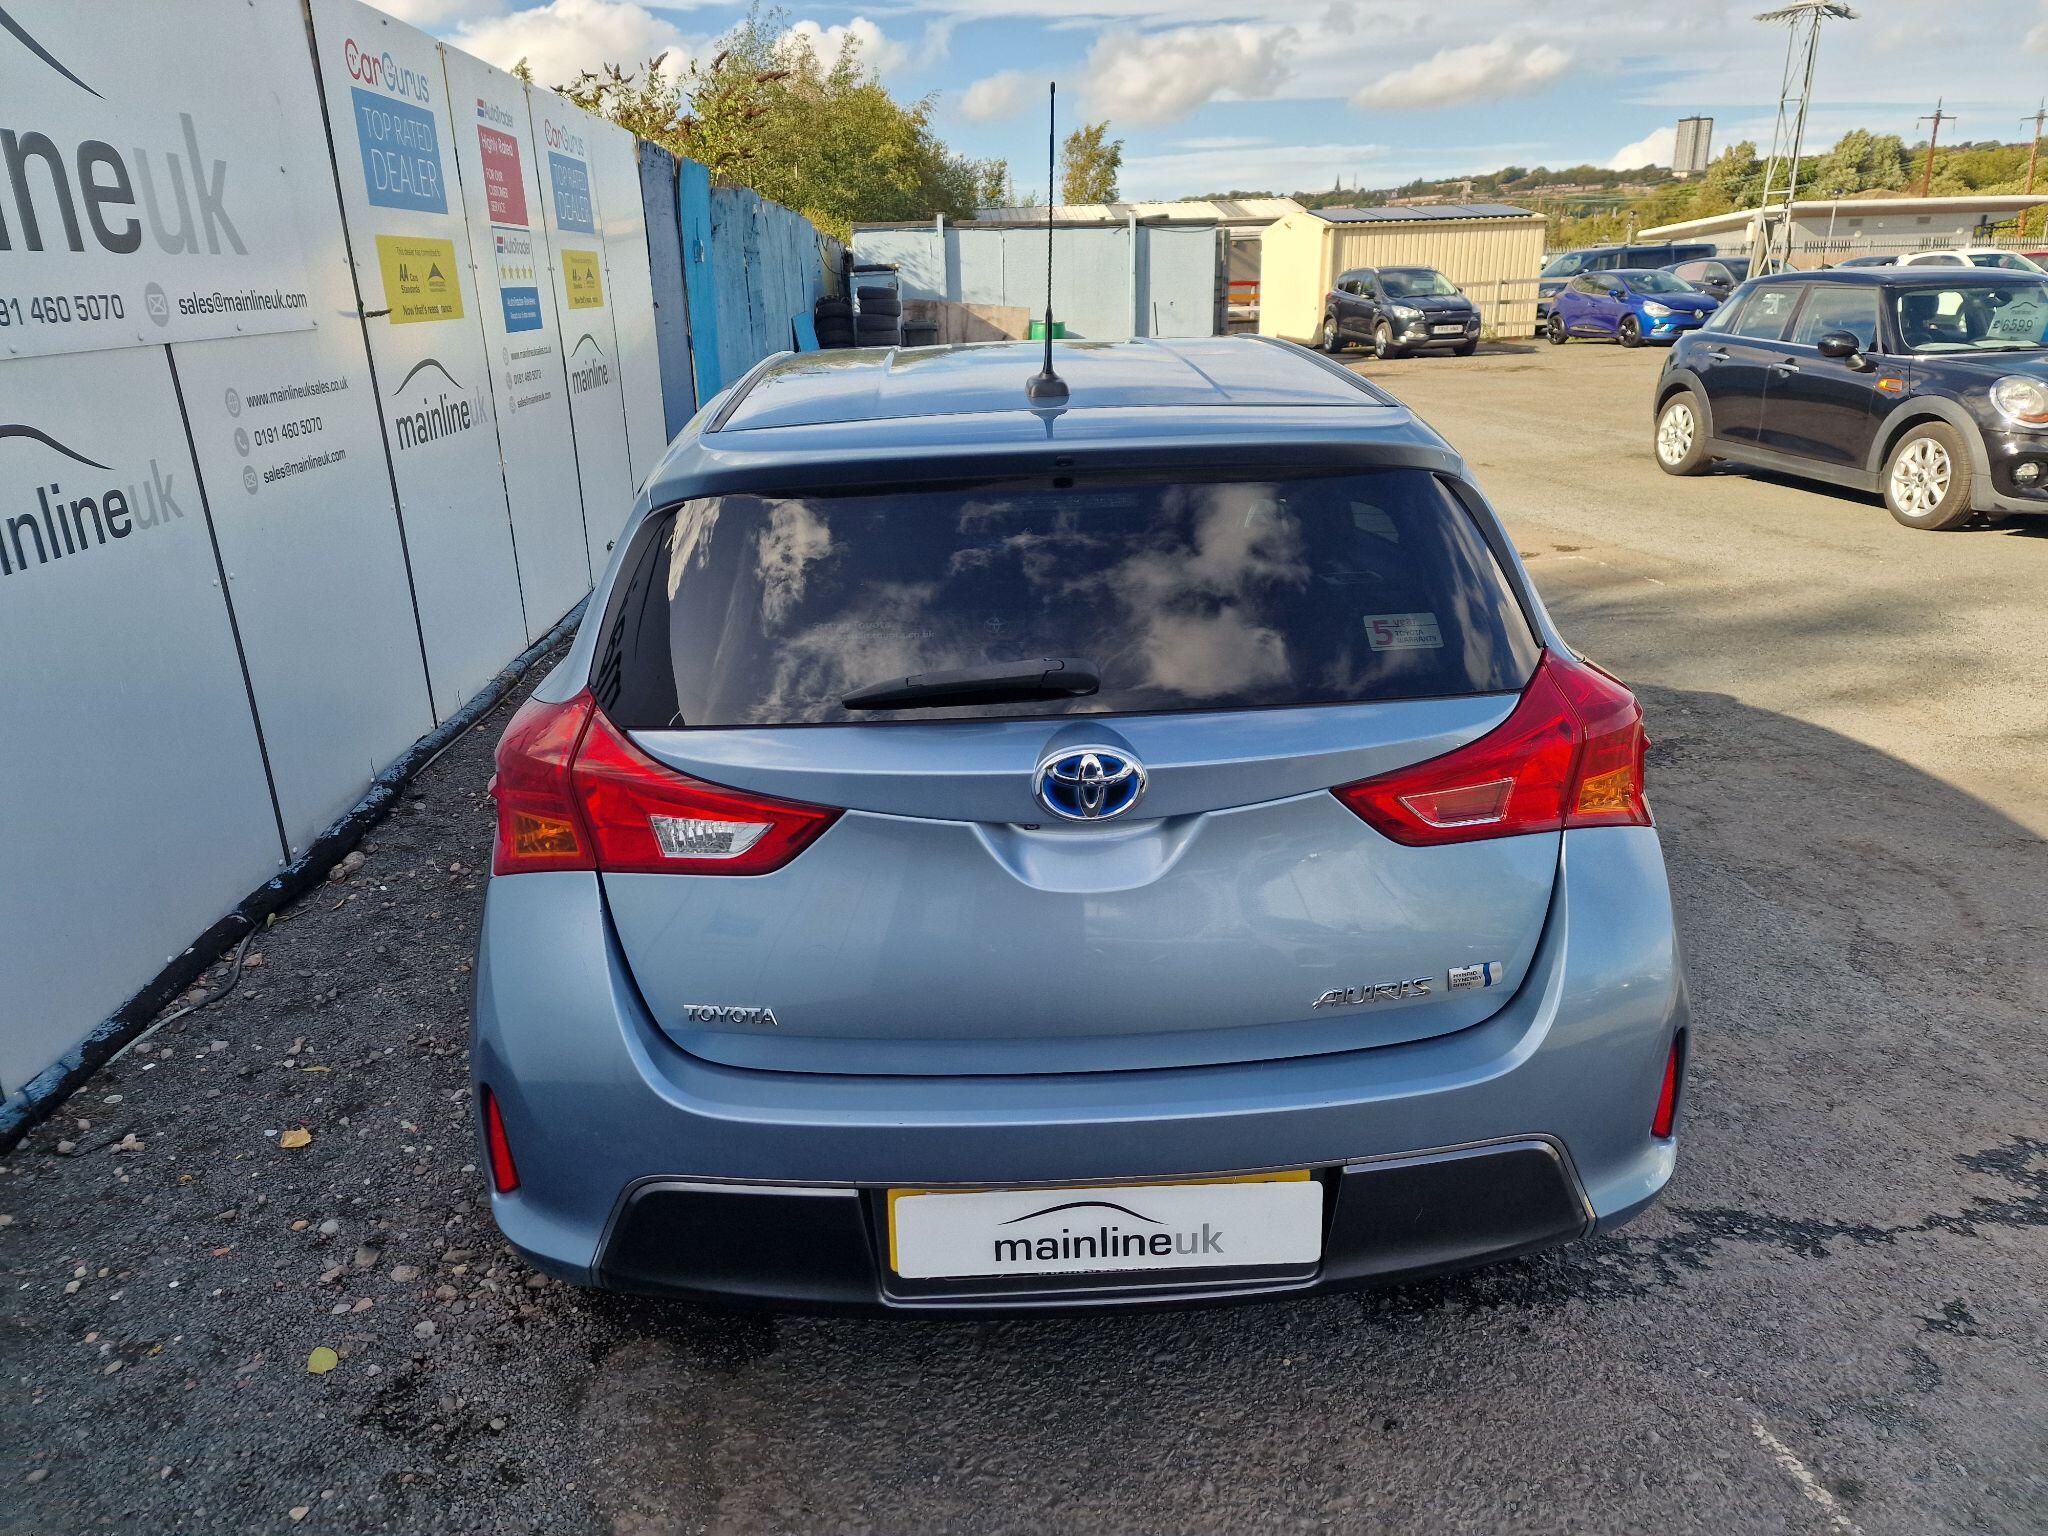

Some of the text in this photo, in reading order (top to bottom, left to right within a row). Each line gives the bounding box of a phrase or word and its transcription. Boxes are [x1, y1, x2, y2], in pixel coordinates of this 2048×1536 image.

[345, 38, 430, 103] CarGurus
[362, 106, 433, 153] TOP RATED
[0, 112, 249, 255] neuk
[371, 148, 440, 199] DEALER
[31, 296, 71, 323] 460
[73, 294, 124, 321] 5070
[178, 288, 308, 315] sales@mainlineuk.com
[246, 376, 349, 408] www.mainlineuksales.co.uk
[254, 417, 323, 446] 0191 460 5070
[395, 385, 488, 450] mainlineuk
[263, 449, 346, 483] sales@mainlineuk.com
[1372, 620, 1393, 645] 5
[1395, 629, 1423, 637] TOYOTA
[1312, 976, 1433, 1010] AURIS
[683, 1004, 778, 1026] TOYOTA
[994, 1223, 1225, 1262] mainlineuk
